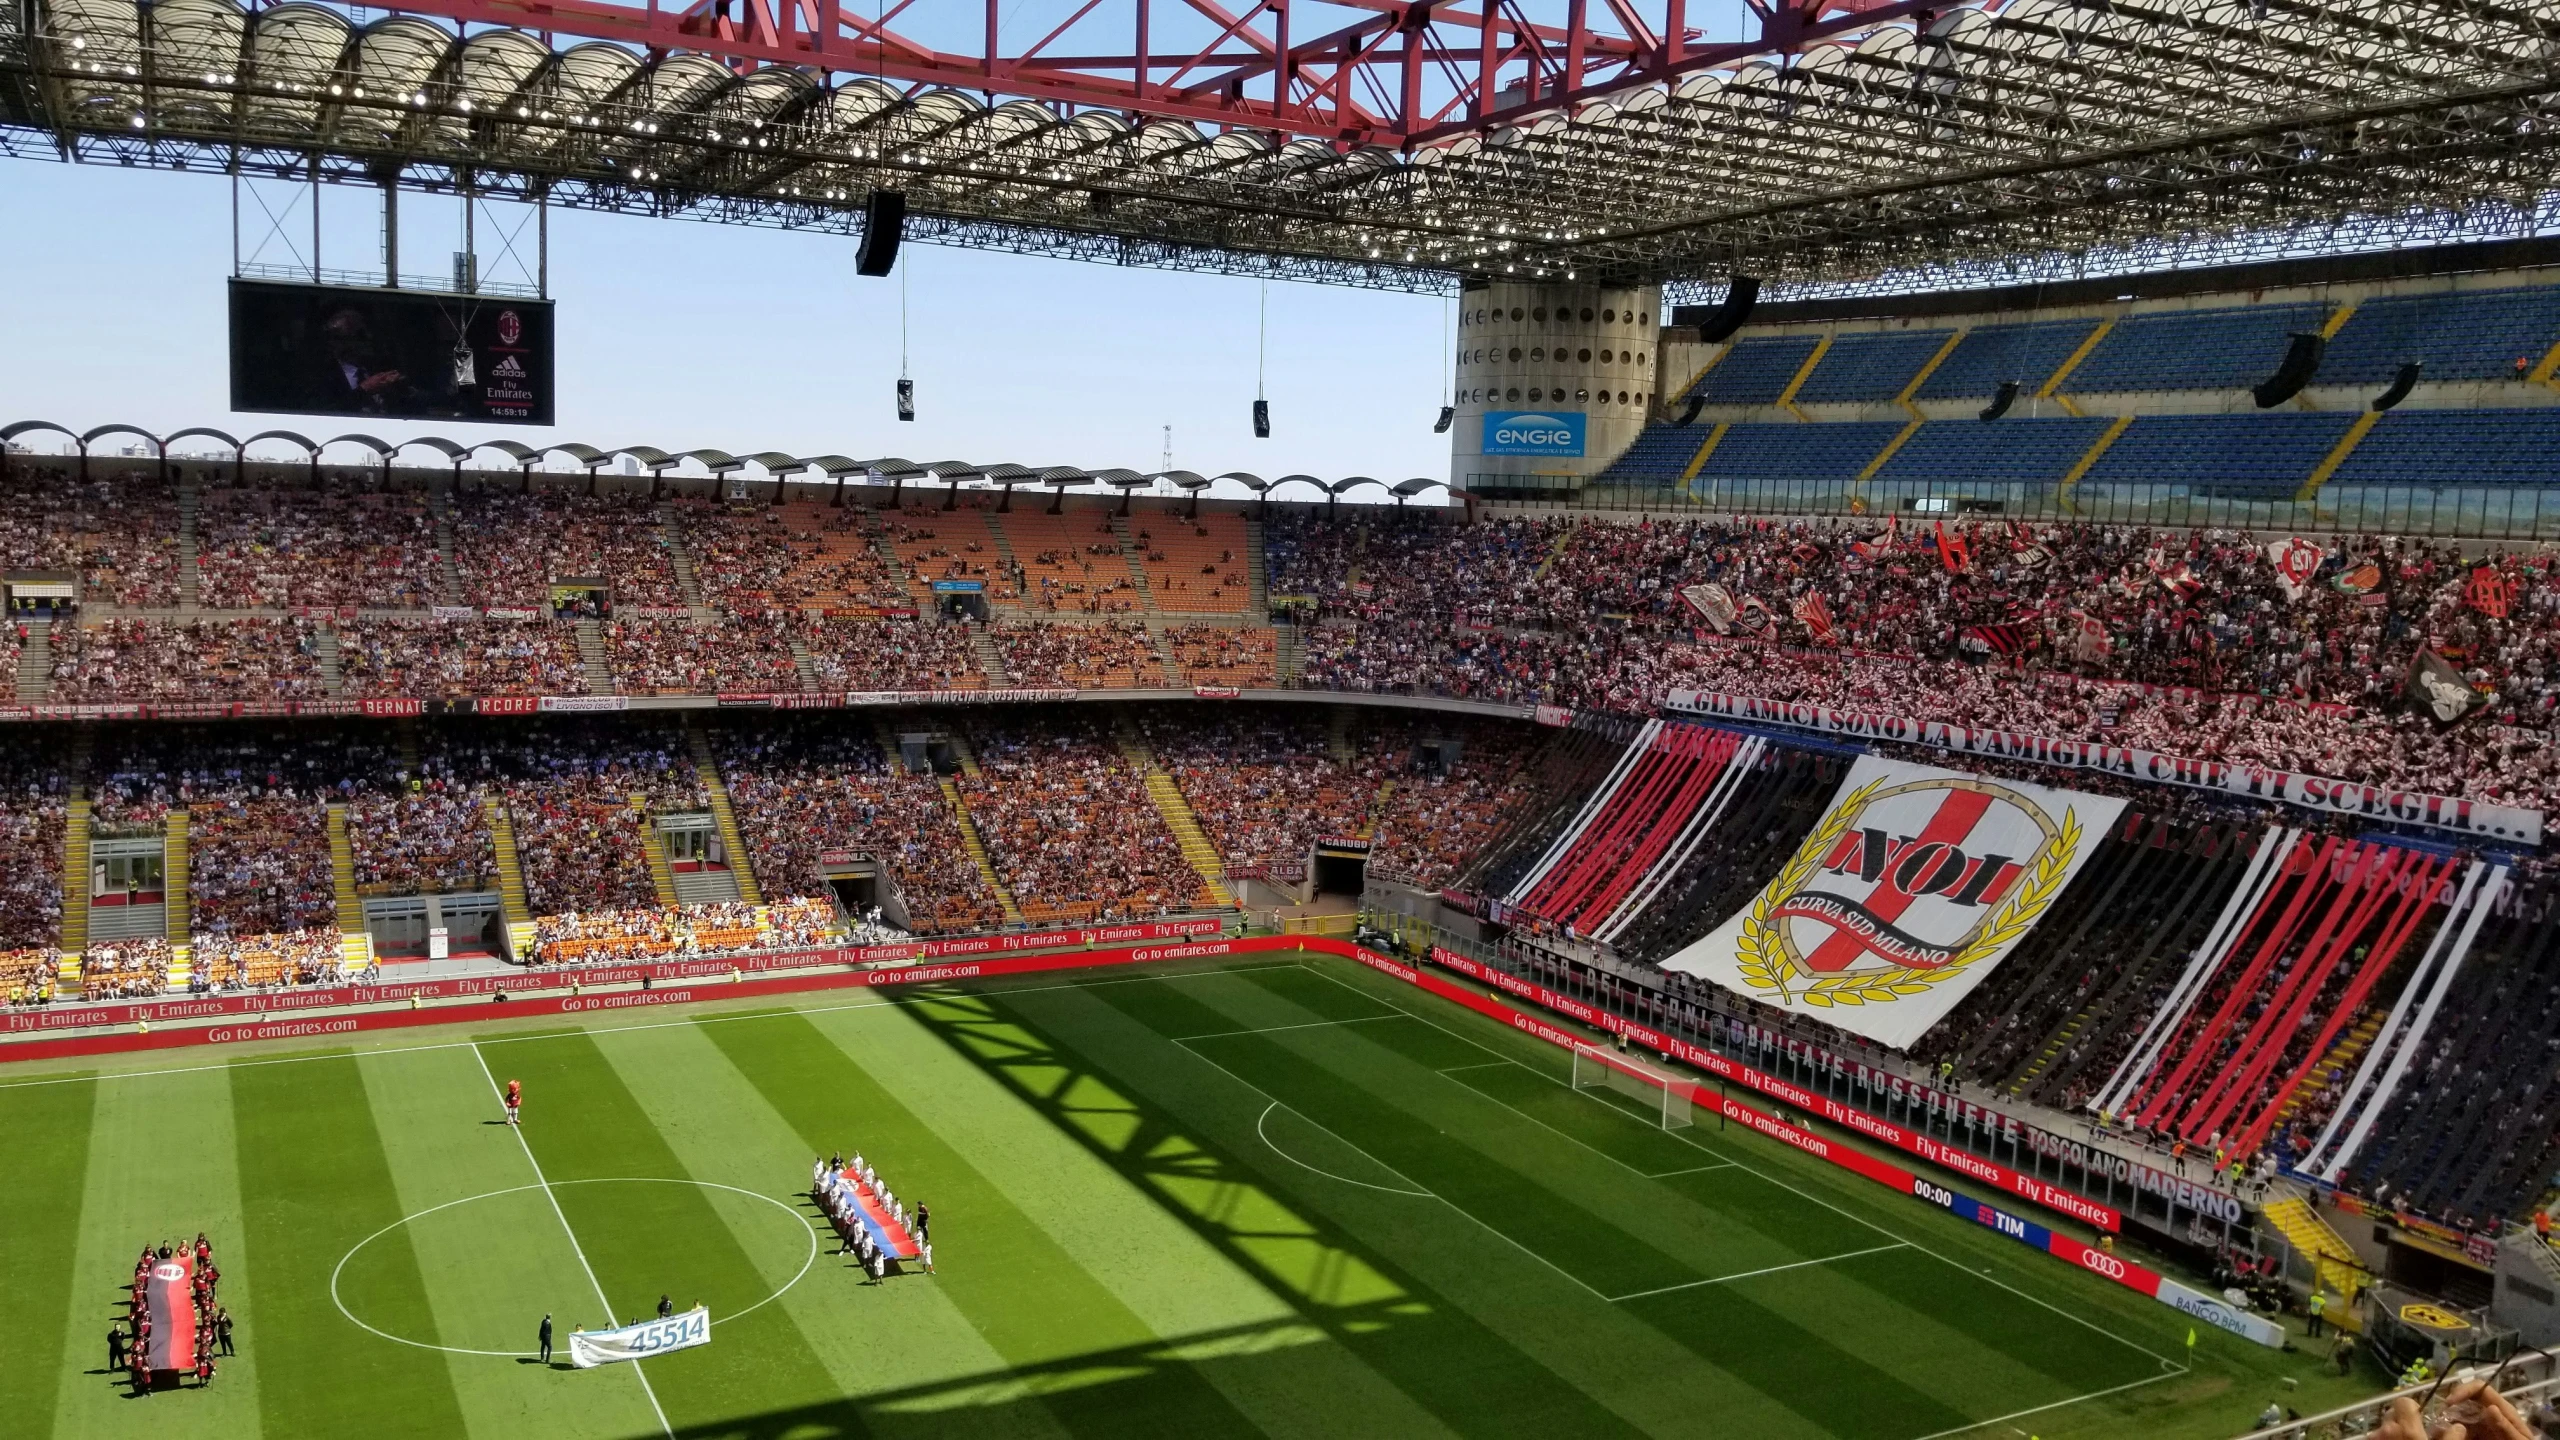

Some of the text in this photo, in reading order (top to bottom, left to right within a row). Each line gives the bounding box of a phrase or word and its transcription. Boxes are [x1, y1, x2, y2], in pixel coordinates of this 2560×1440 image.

[492, 368, 526, 378] adidas
[487, 387, 532, 399] Emirates
[503, 380, 517, 389] Fly
[491, 407, 528, 416] 14:59:19
[640, 608, 691, 618] CORSO LODI
[1471, 616, 1493, 627] MCF
[1864, 653, 1911, 668] TOSCANA
[932, 690, 975, 702] MAGLIA
[987, 689, 1048, 701] ROSSONERA
[366, 700, 428, 714] BERNATE
[472, 698, 532, 712] ARCORE
[556, 702, 593, 710] LIVIGNO
[1742, 698, 1820, 727] AMICI
[1829, 710, 1906, 739] SONO
[1916, 720, 1953, 748] LA
[1963, 727, 2137, 775] FAMIGLIA
[2148, 754, 2232, 789] CHE
[2244, 767, 2290, 799] TI
[1325, 838, 1368, 849] CARUGO
[821, 853, 866, 862] FEMMINILE
[1271, 866, 1303, 876] ALBA
[1828, 827, 2014, 907] NOI
[1081, 928, 1142, 941] Fly Emirates
[1156, 922, 1214, 936] Fly Emirates
[1784, 896, 1950, 965] CURVA SUD MILANO
[923, 940, 989, 956] Fly Emirates
[1004, 934, 1067, 949] Fly Emirates
[838, 947, 908, 962] Fly Emirates
[1132, 942, 1230, 960] Go to emirates.com
[657, 961, 733, 978] Fly Emirates
[750, 953, 822, 970] Fly Emirates
[1356, 948, 1417, 983] Go to emirates.com
[1435, 947, 1477, 974] Fly Emirates
[560, 969, 640, 985] Fly Emirates
[868, 964, 980, 984] Go to emirates.com
[1485, 967, 1532, 996] Fly Emirates
[354, 984, 440, 1002] Fly Emirates
[459, 976, 542, 994] Fly Emirates
[1513, 940, 1570, 976] FOSSA
[1639, 986, 1706, 1029] LEONI
[244, 993, 334, 1011] Fly Emirates
[562, 989, 691, 1011] Go to emirates.com
[1541, 989, 1592, 1019] Fly Emirates
[130, 1002, 223, 1020] Fly Emirates
[12, 1011, 108, 1030] Fly Emirates
[1603, 1012, 1658, 1045] Fly Emirates
[208, 1018, 357, 1043] Go to emirates.com
[1515, 1013, 1592, 1057] Go to emirates.com
[1670, 1038, 1731, 1074] Fly Emirates
[1744, 1068, 1811, 1107] Fly Emirates
[1747, 1025, 2018, 1144] BRIGATE ROSSONERE
[1723, 1100, 1827, 1156] Go to emirates.com
[1826, 1099, 1900, 1142] Fly Emirates
[1917, 1135, 1999, 1182] Fly Emirates
[2027, 1127, 2241, 1223] TOSCOLANO MADERNO
[1914, 1179, 1952, 1207] 00:00
[2017, 1175, 2109, 1225] Fly Emirates
[1996, 1212, 2025, 1238] TIM
[2176, 1296, 2247, 1335] BANCO BPM
[629, 1315, 704, 1352] 45514
